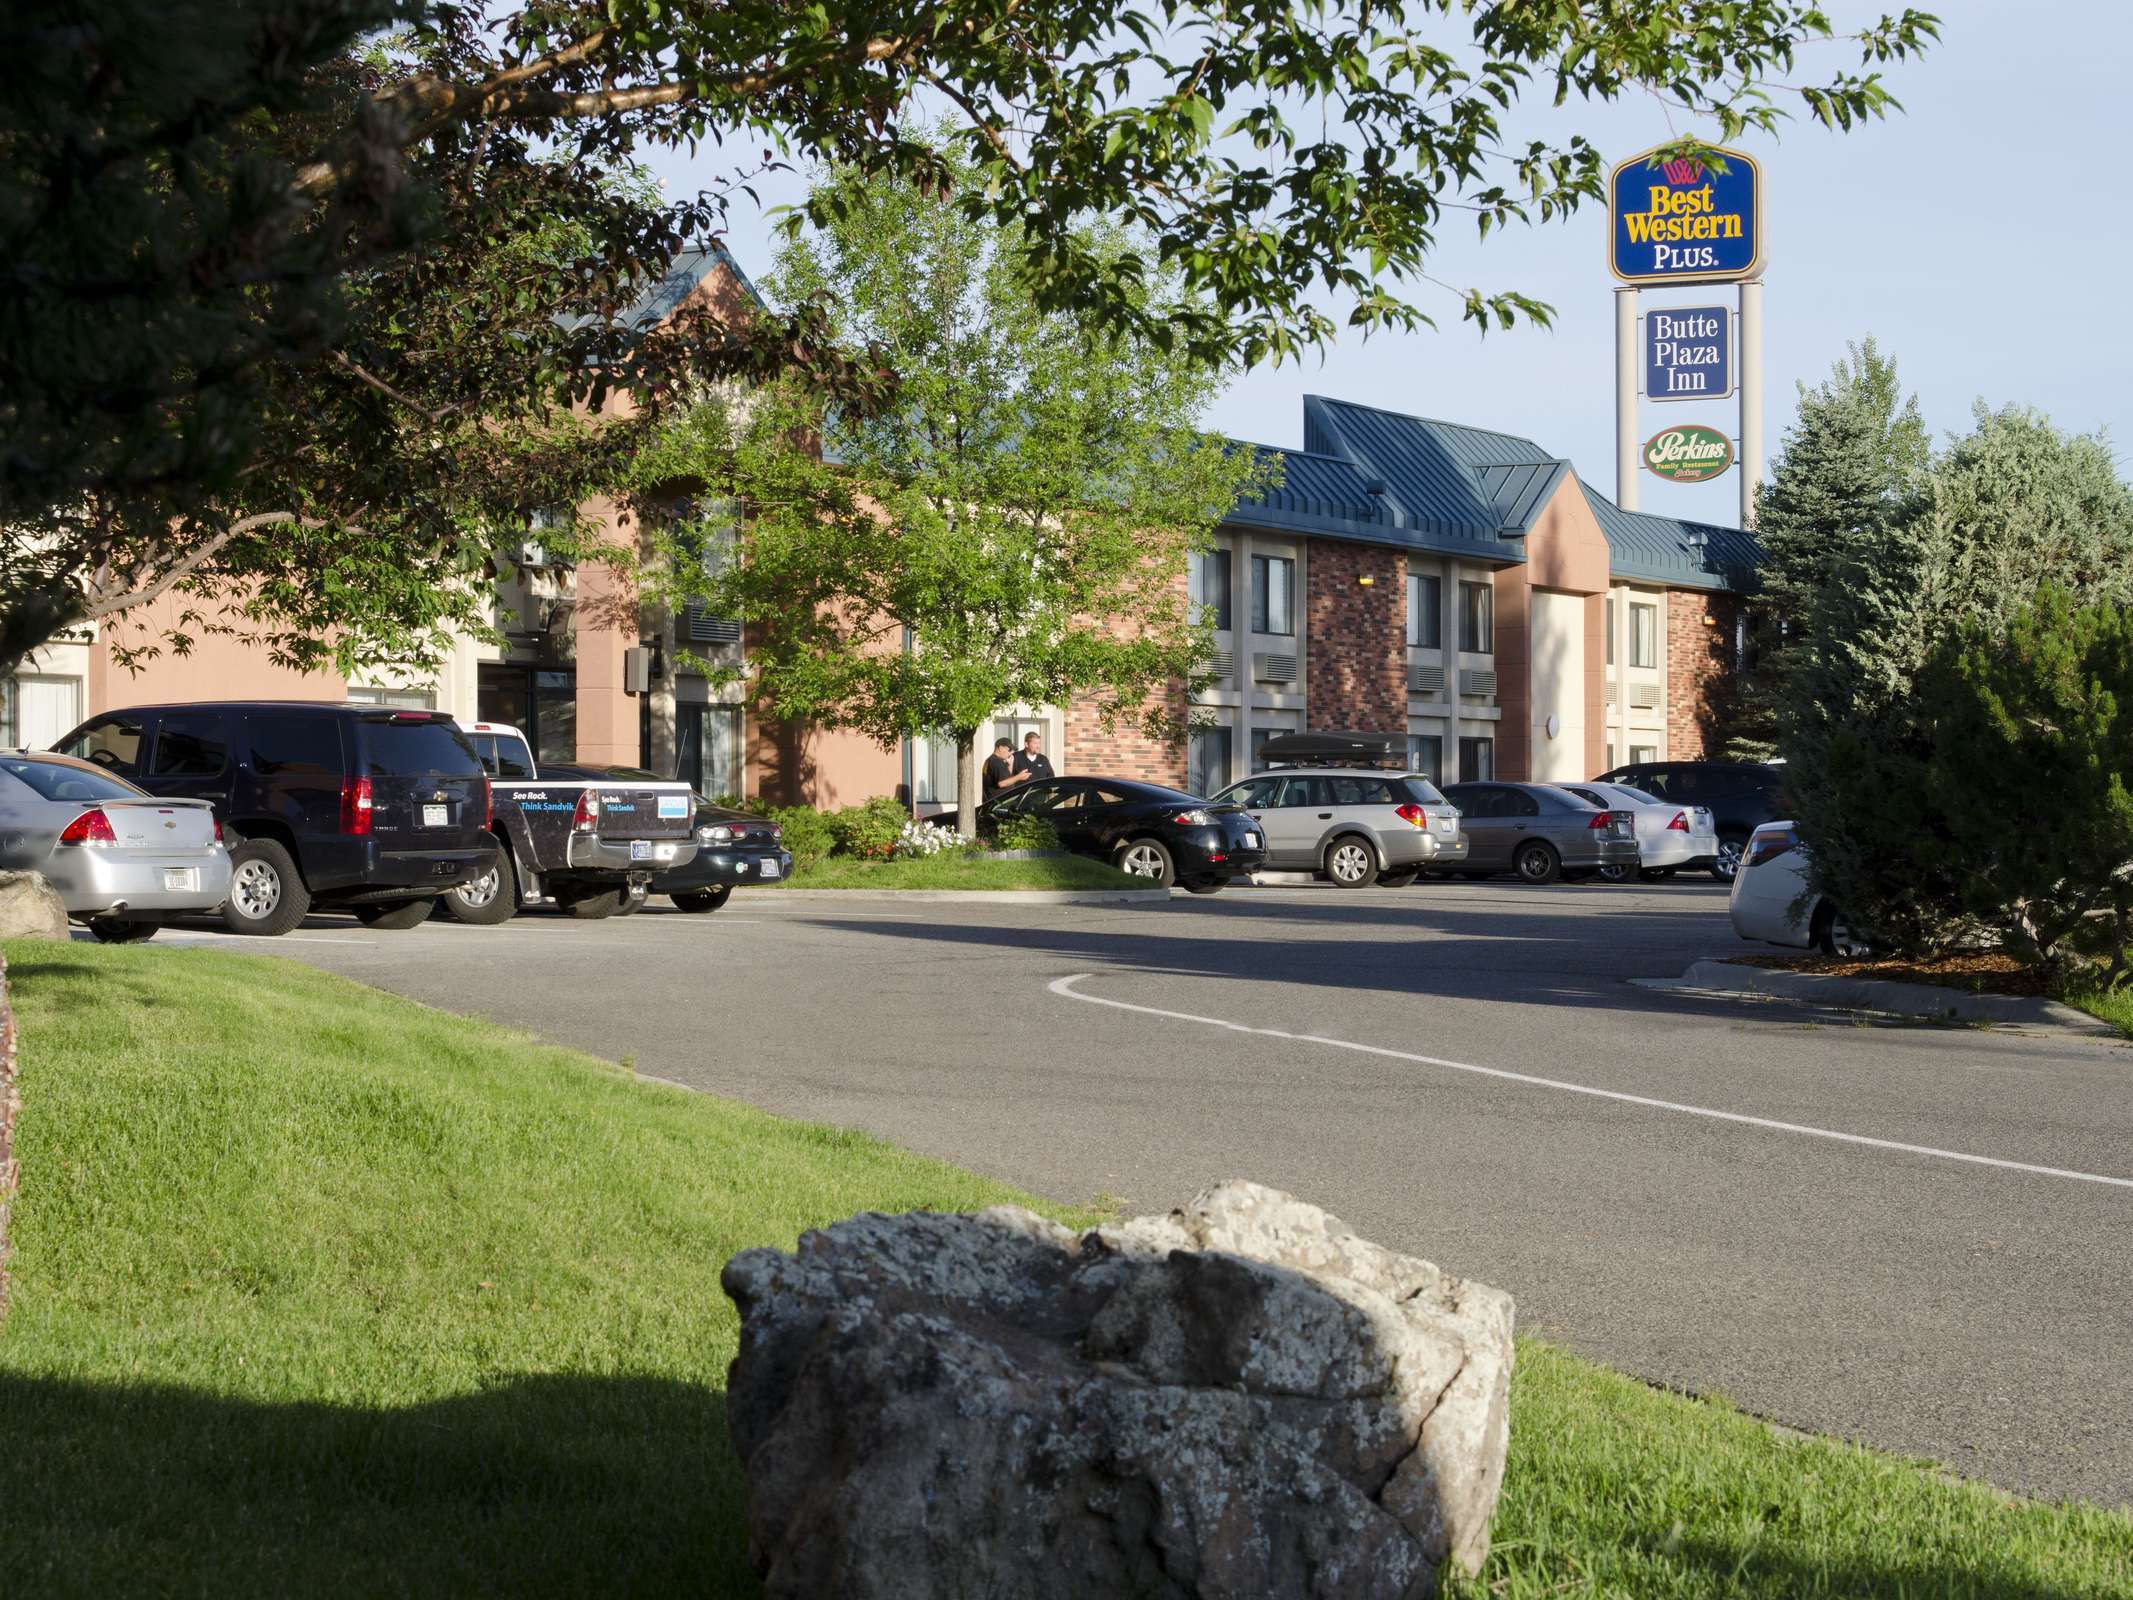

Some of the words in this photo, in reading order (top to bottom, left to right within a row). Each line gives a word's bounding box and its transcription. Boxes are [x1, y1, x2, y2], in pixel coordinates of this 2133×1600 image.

[1648, 183, 1715, 215] Best
[1624, 213, 1743, 243] Western
[1655, 315, 1719, 340] Butte
[1654, 342, 1720, 366] Plaza
[1667, 367, 1707, 391] Inn
[1648, 432, 1725, 463] Perkins
[512, 792, 526, 800] See
[527, 791, 548, 800] Rock.
[521, 802, 542, 811] Think
